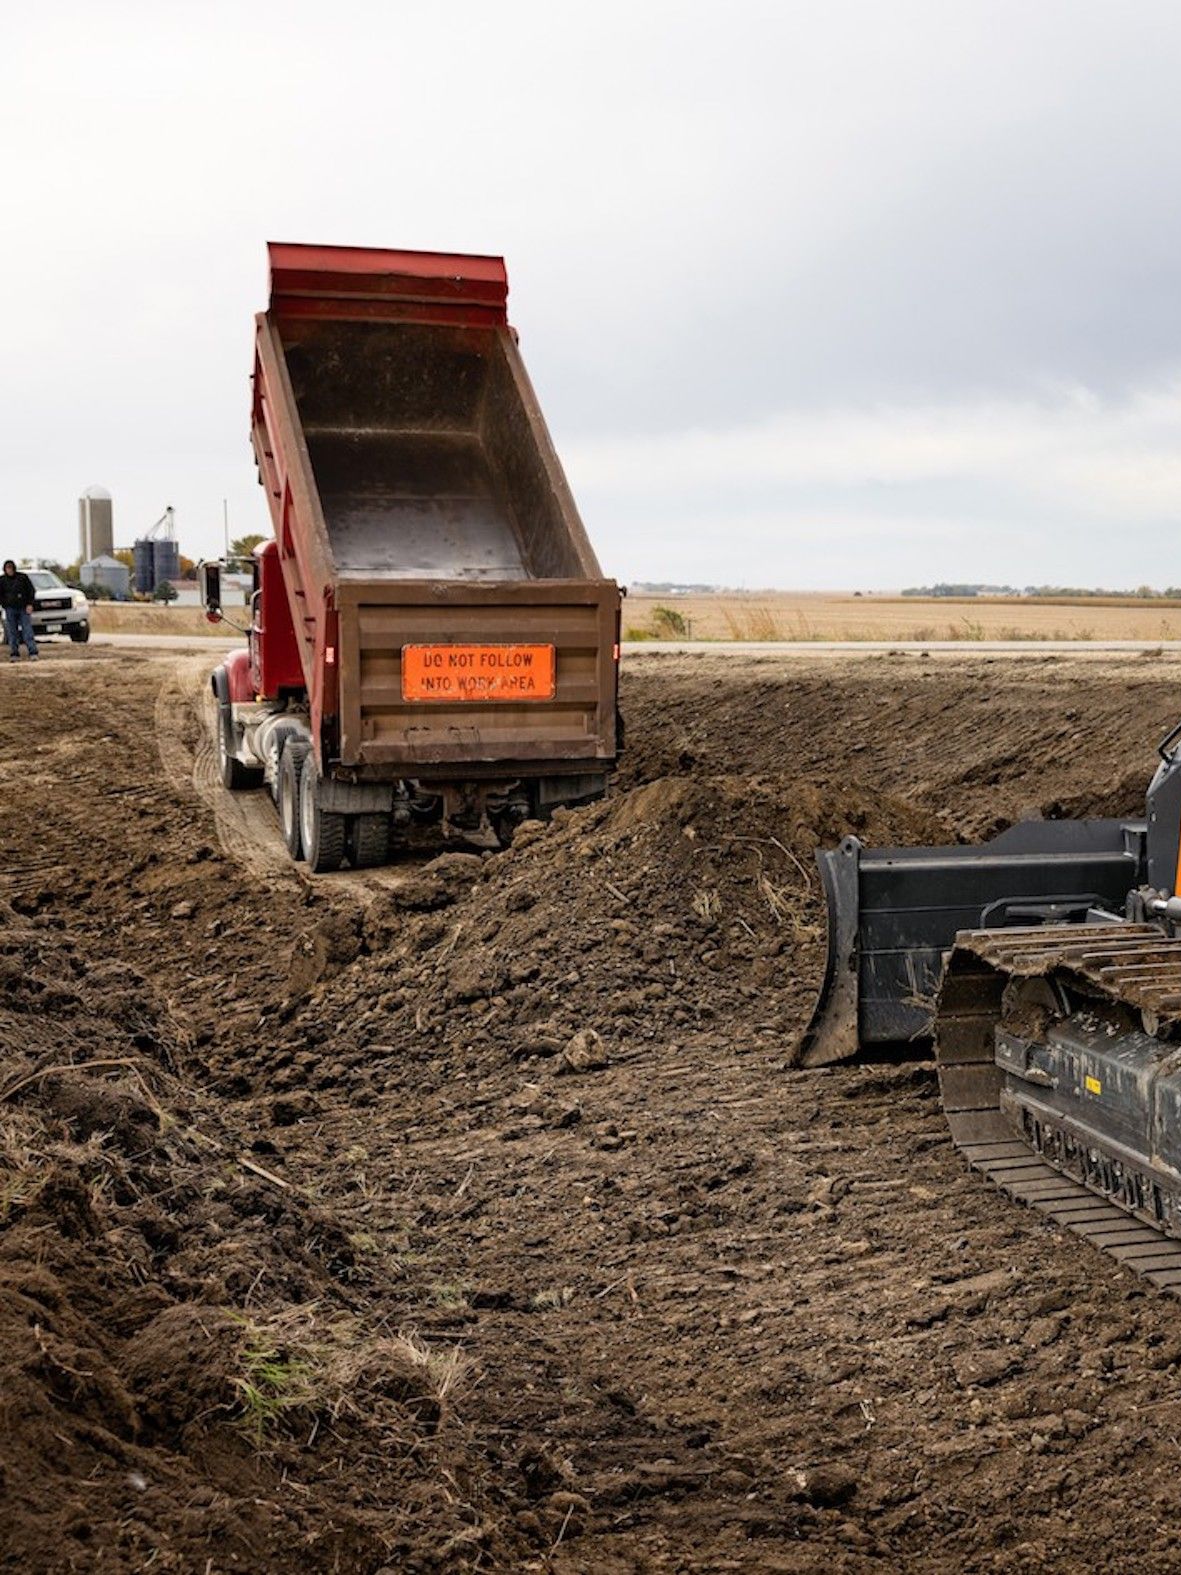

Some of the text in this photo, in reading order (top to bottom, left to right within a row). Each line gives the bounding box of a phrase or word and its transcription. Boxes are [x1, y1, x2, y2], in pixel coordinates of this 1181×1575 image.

[424, 654, 533, 667] DO NOT FOLLOW
